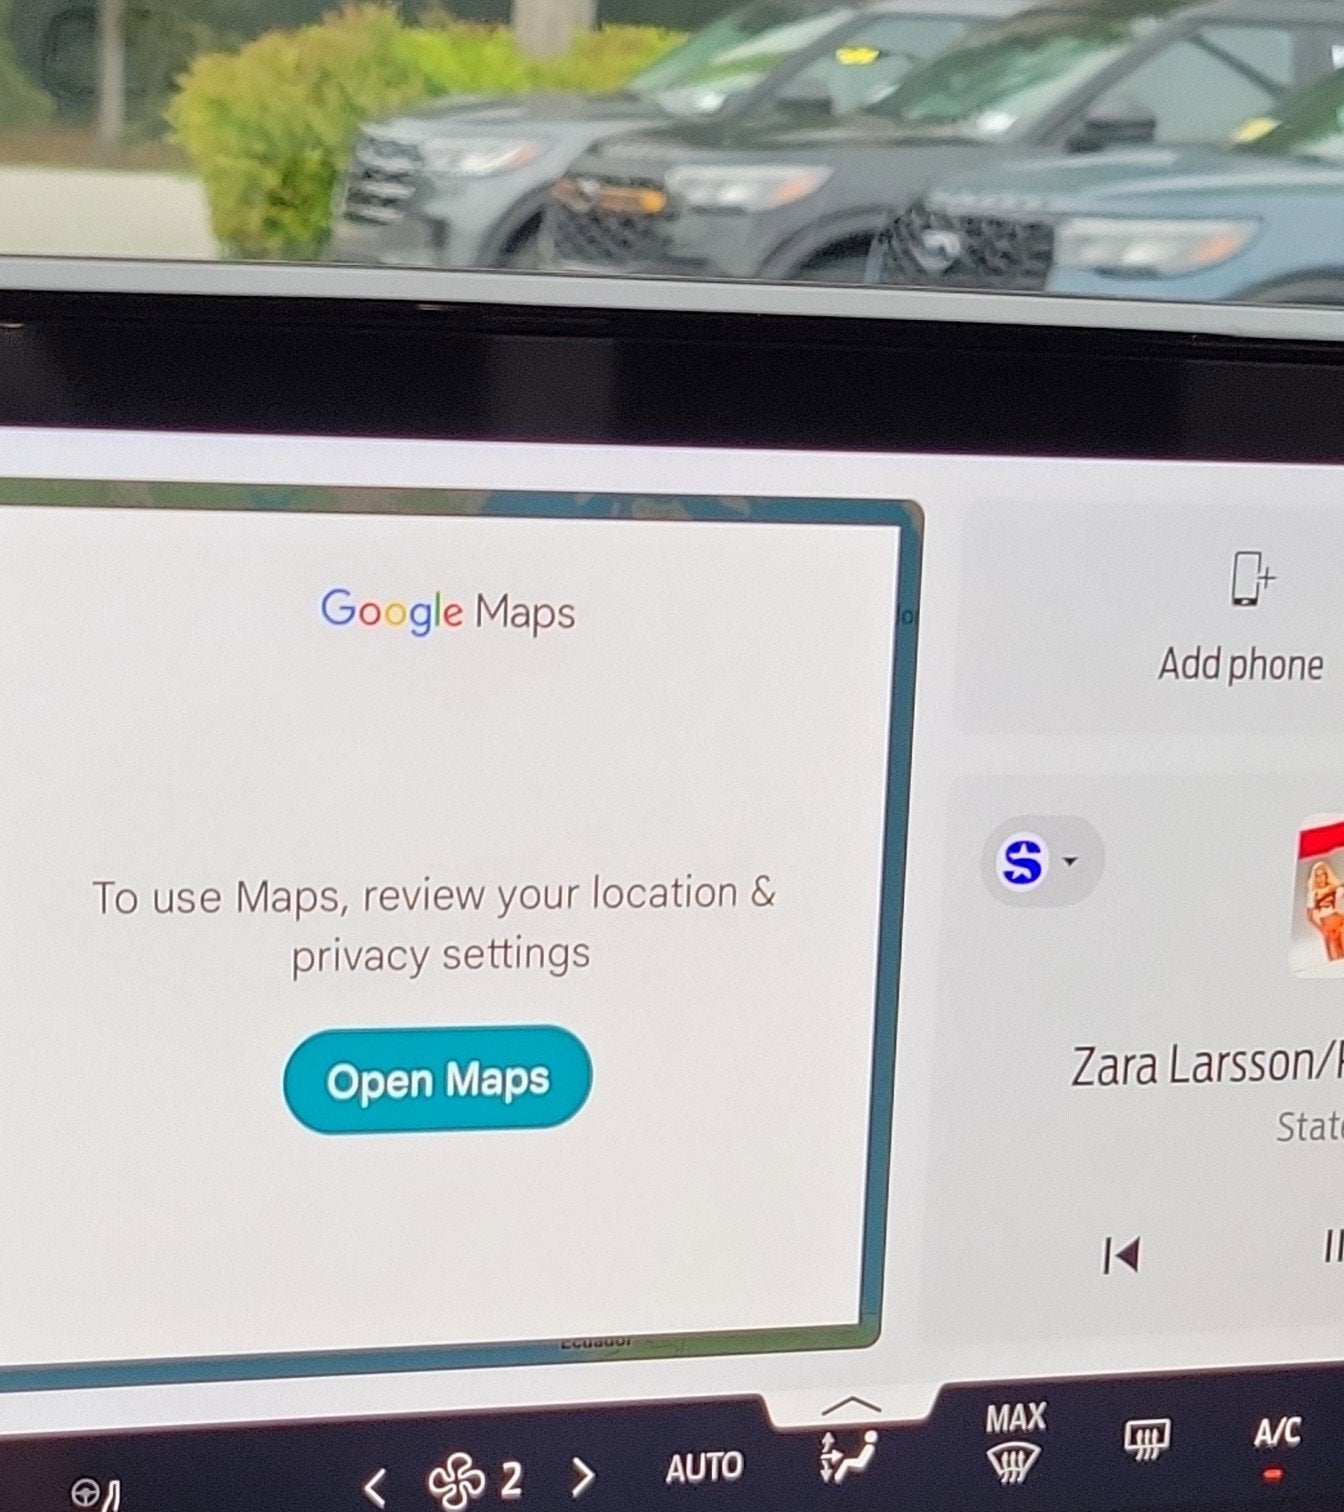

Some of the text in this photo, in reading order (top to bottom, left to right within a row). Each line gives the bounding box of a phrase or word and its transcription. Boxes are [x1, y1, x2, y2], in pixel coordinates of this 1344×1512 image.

[320, 587, 575, 638] Google Maps
[1158, 645, 1324, 687] Add phone
[92, 873, 776, 922] To use Maps, review your location &
[293, 934, 590, 982] privacy settings
[327, 1061, 549, 1108] Open Maps
[1072, 1046, 1157, 1086] Zara
[986, 1401, 1047, 1433] MAX
[1253, 1416, 1302, 1447] A/C
[501, 1461, 522, 1498] 2
[665, 1450, 743, 1484] AUTO
